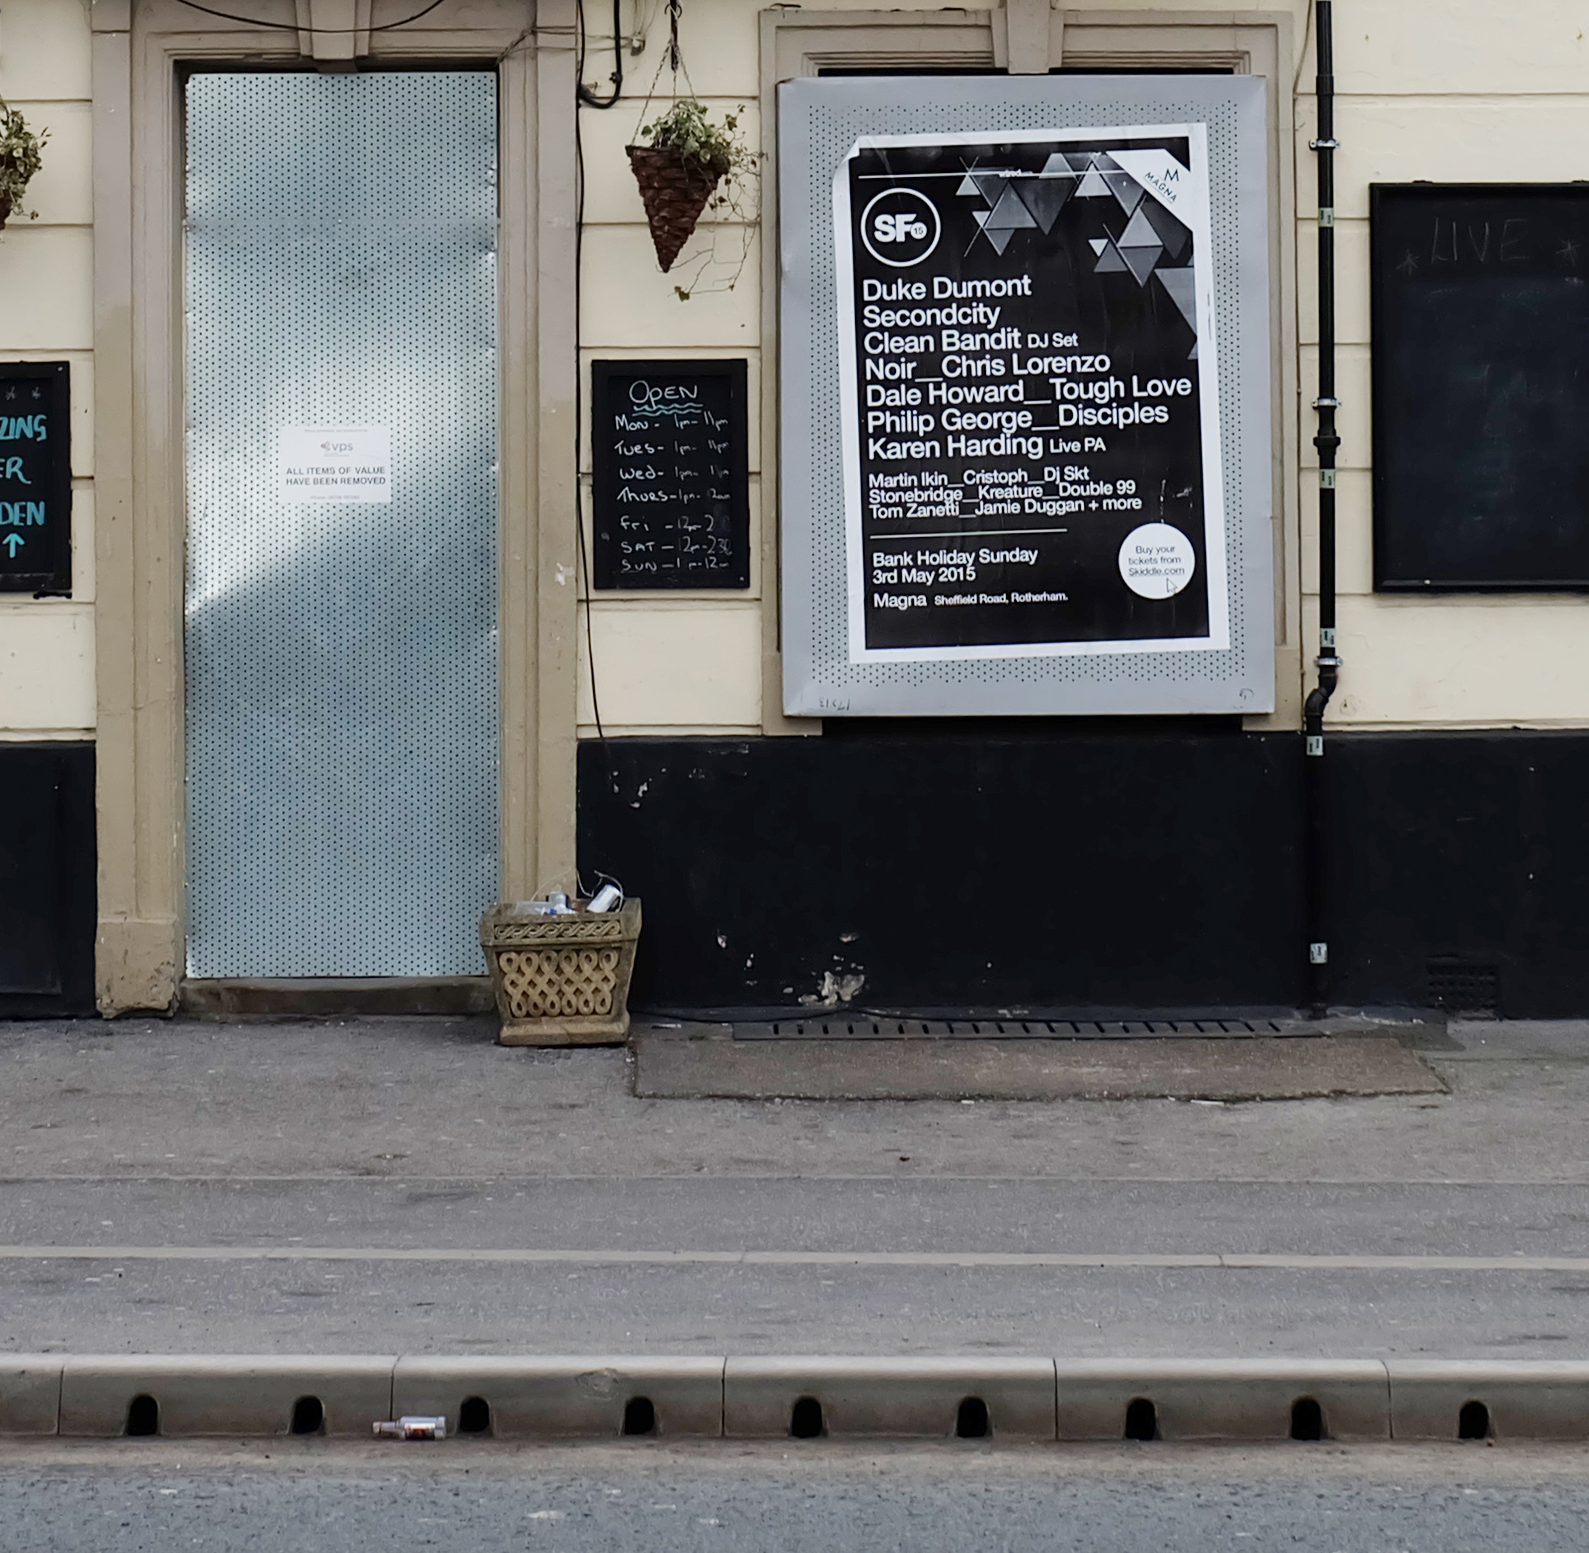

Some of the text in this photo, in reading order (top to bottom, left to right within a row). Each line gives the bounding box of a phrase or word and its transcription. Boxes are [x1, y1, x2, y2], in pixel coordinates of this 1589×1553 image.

[1144, 171, 1177, 203] MAGNA
[1431, 216, 1529, 265] LIVE
[863, 274, 1032, 301] Duke Dumont
[863, 301, 1001, 329] Secondcity
[864, 327, 1079, 354] Clean Bandit DJ Set
[1012, 353, 1110, 375] Lorenzo
[866, 383, 922, 407] Dale
[1132, 375, 1192, 397] Love
[867, 410, 935, 437] Philip
[331, 443, 353, 452] vps
[868, 432, 1106, 460] Karen Harding Live PA
[286, 466, 385, 476] ALL ITEMS OF VALUE
[286, 477, 386, 485] HAVE BEEN REMOVED
[869, 472, 918, 488] Martin
[1064, 465, 1090, 481] Skt
[1116, 479, 1136, 495] 99
[869, 504, 903, 519] Tom
[1024, 498, 1085, 516] Duggan
[1102, 497, 1142, 510] more
[621, 540, 655, 554] SAT
[873, 547, 1038, 567] Bank Holiday Sunday
[1135, 545, 1175, 555] Buy your
[621, 559, 657, 571] SUN
[1128, 556, 1181, 565] tickets from
[872, 566, 976, 586] 3rd May 2015
[1128, 567, 1185, 576] Skiddle.com
[874, 593, 927, 610] Magna
[934, 594, 977, 606] Sheffield
[979, 593, 1009, 604] Road,
